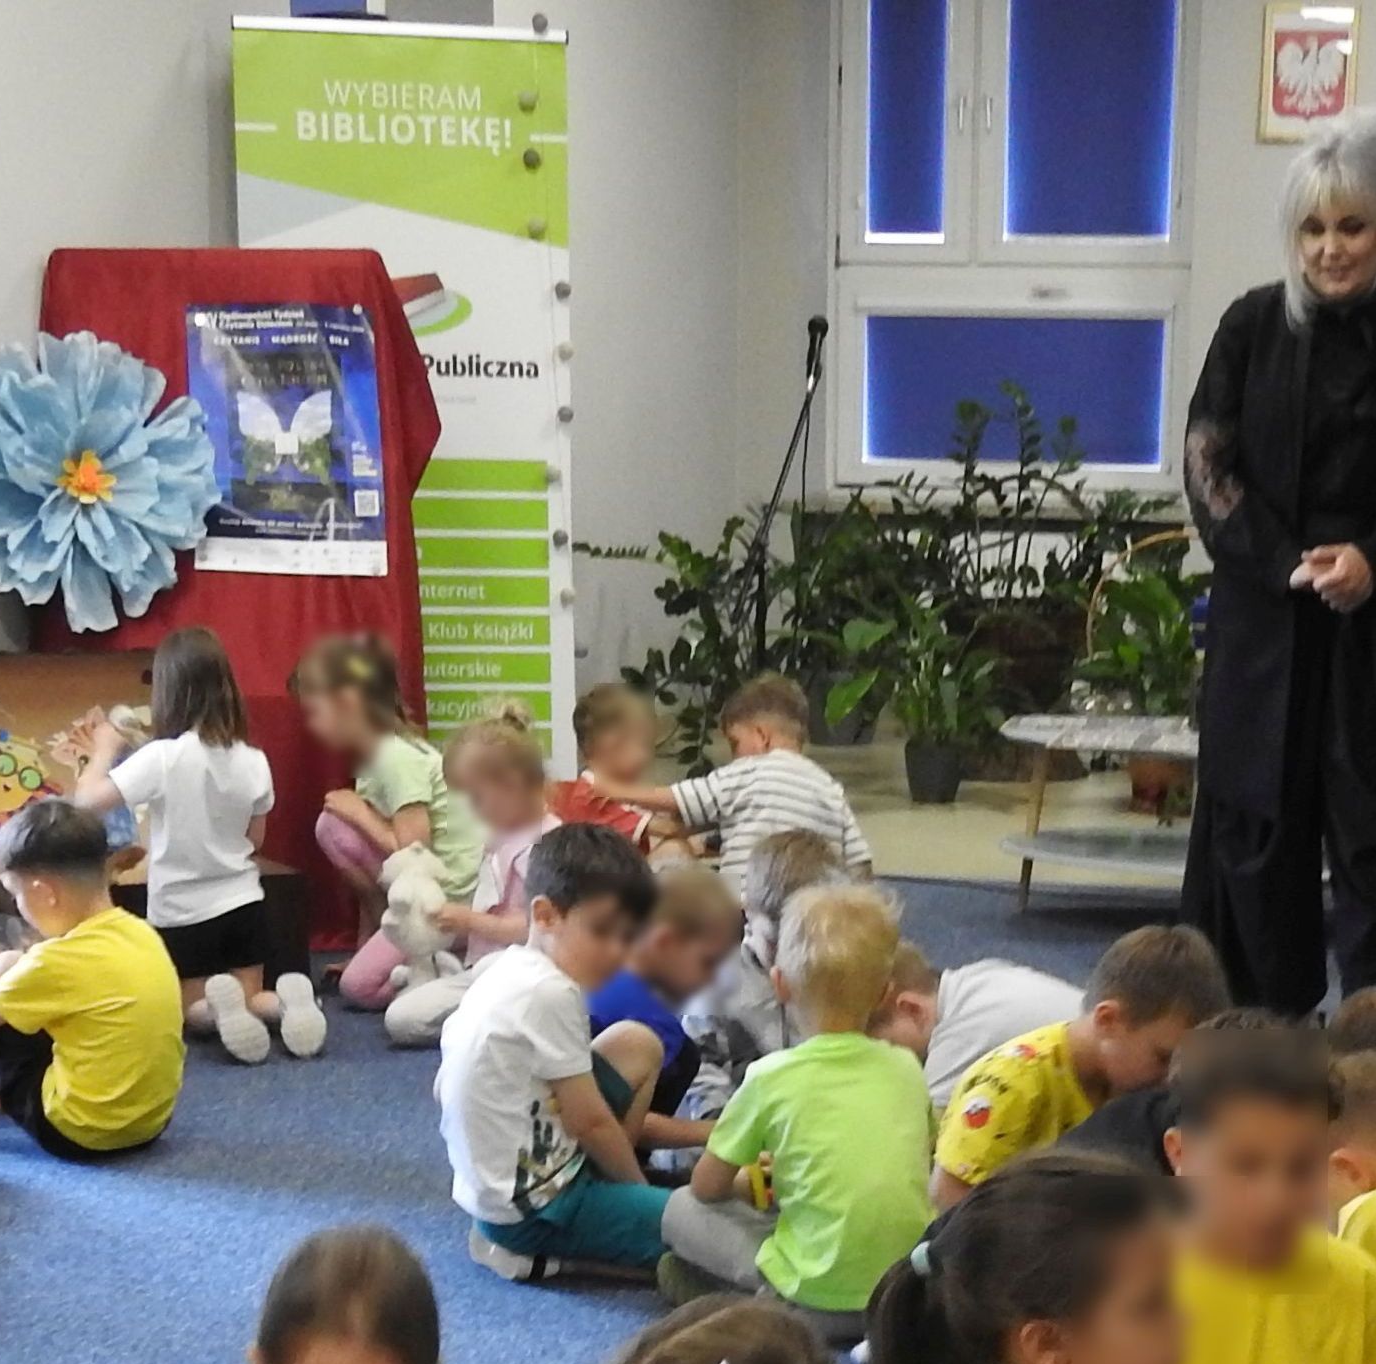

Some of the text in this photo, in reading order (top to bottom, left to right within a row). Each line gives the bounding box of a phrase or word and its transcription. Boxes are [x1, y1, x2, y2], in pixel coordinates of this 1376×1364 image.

[324, 80, 482, 111] WYBIERAM
[296, 110, 512, 156] BIBLIOTEKĘ!
[422, 353, 539, 378] Publiczna
[419, 584, 486, 600] nternet
[428, 622, 534, 644] Klub Książki
[423, 659, 502, 678] utorskie
